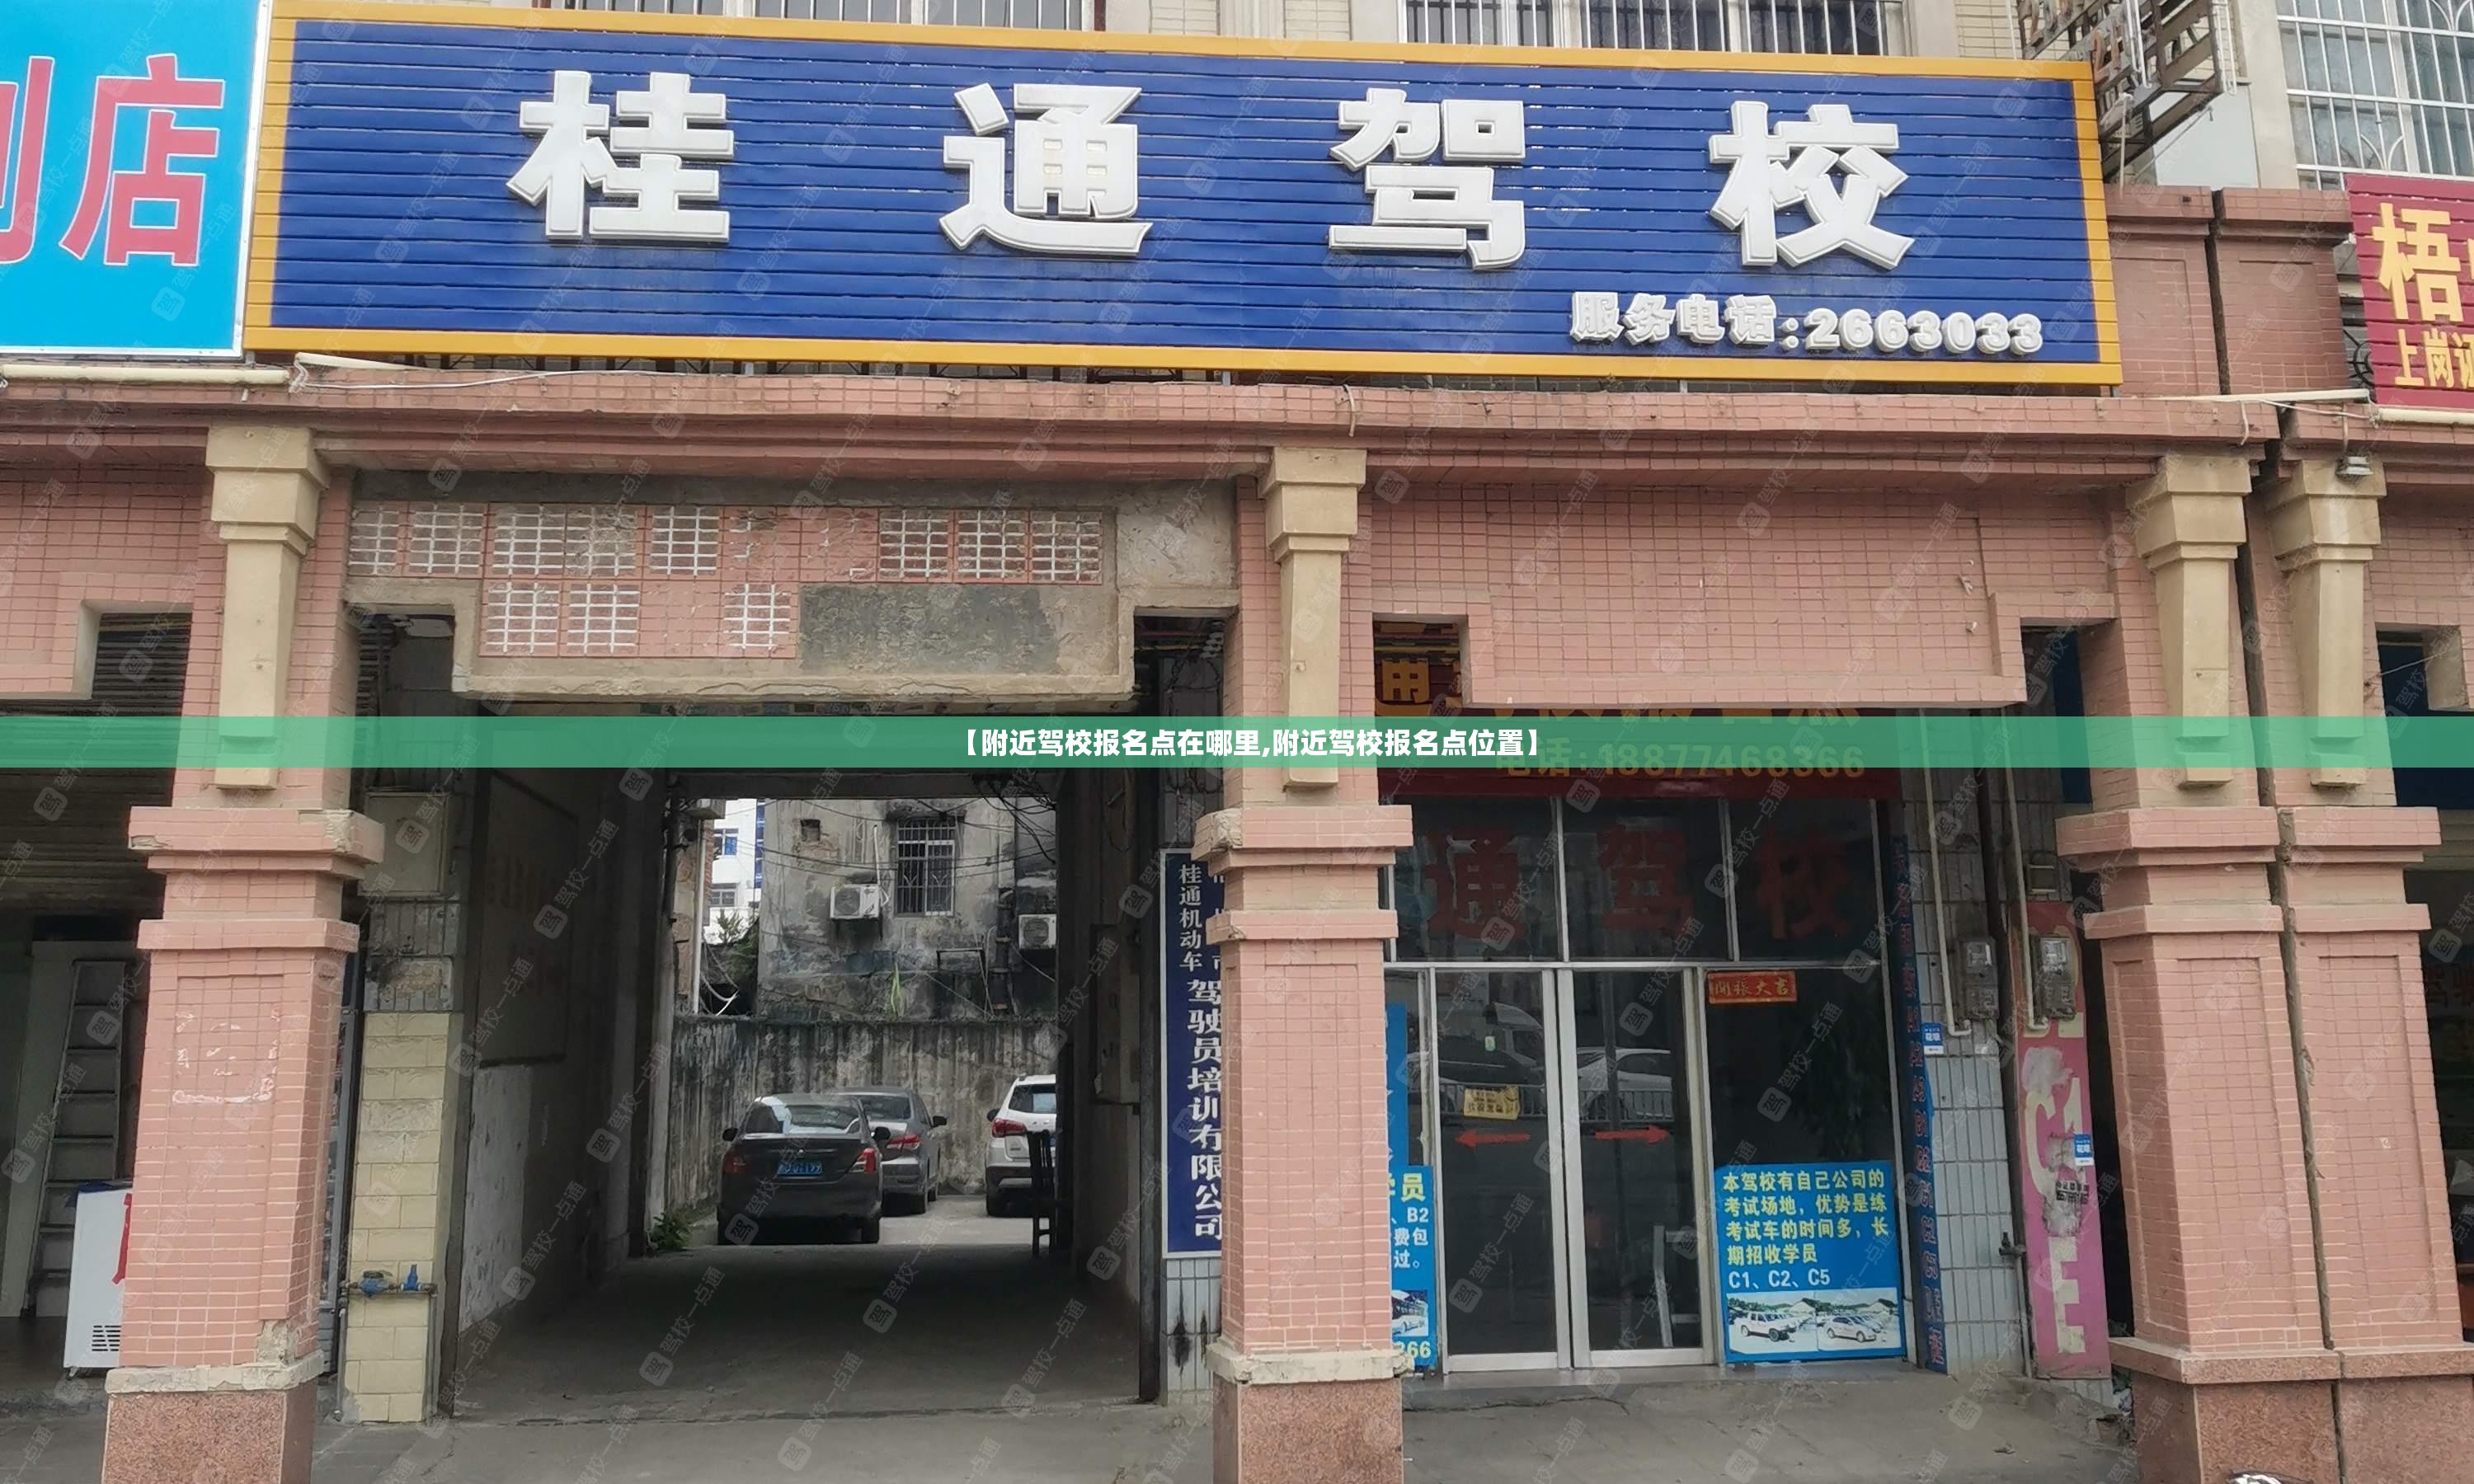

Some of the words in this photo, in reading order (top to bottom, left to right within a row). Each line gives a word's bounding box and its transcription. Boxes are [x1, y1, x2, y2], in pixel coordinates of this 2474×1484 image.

[506, 70, 1916, 270] 桂通驾校
[2372, 203, 2474, 322] 梧
[1178, 864, 1203, 972] 桂通机动车
[1723, 1168, 1885, 1193] 本驾校有自己公司的
[1727, 1243, 1818, 1266] 期招收学员
